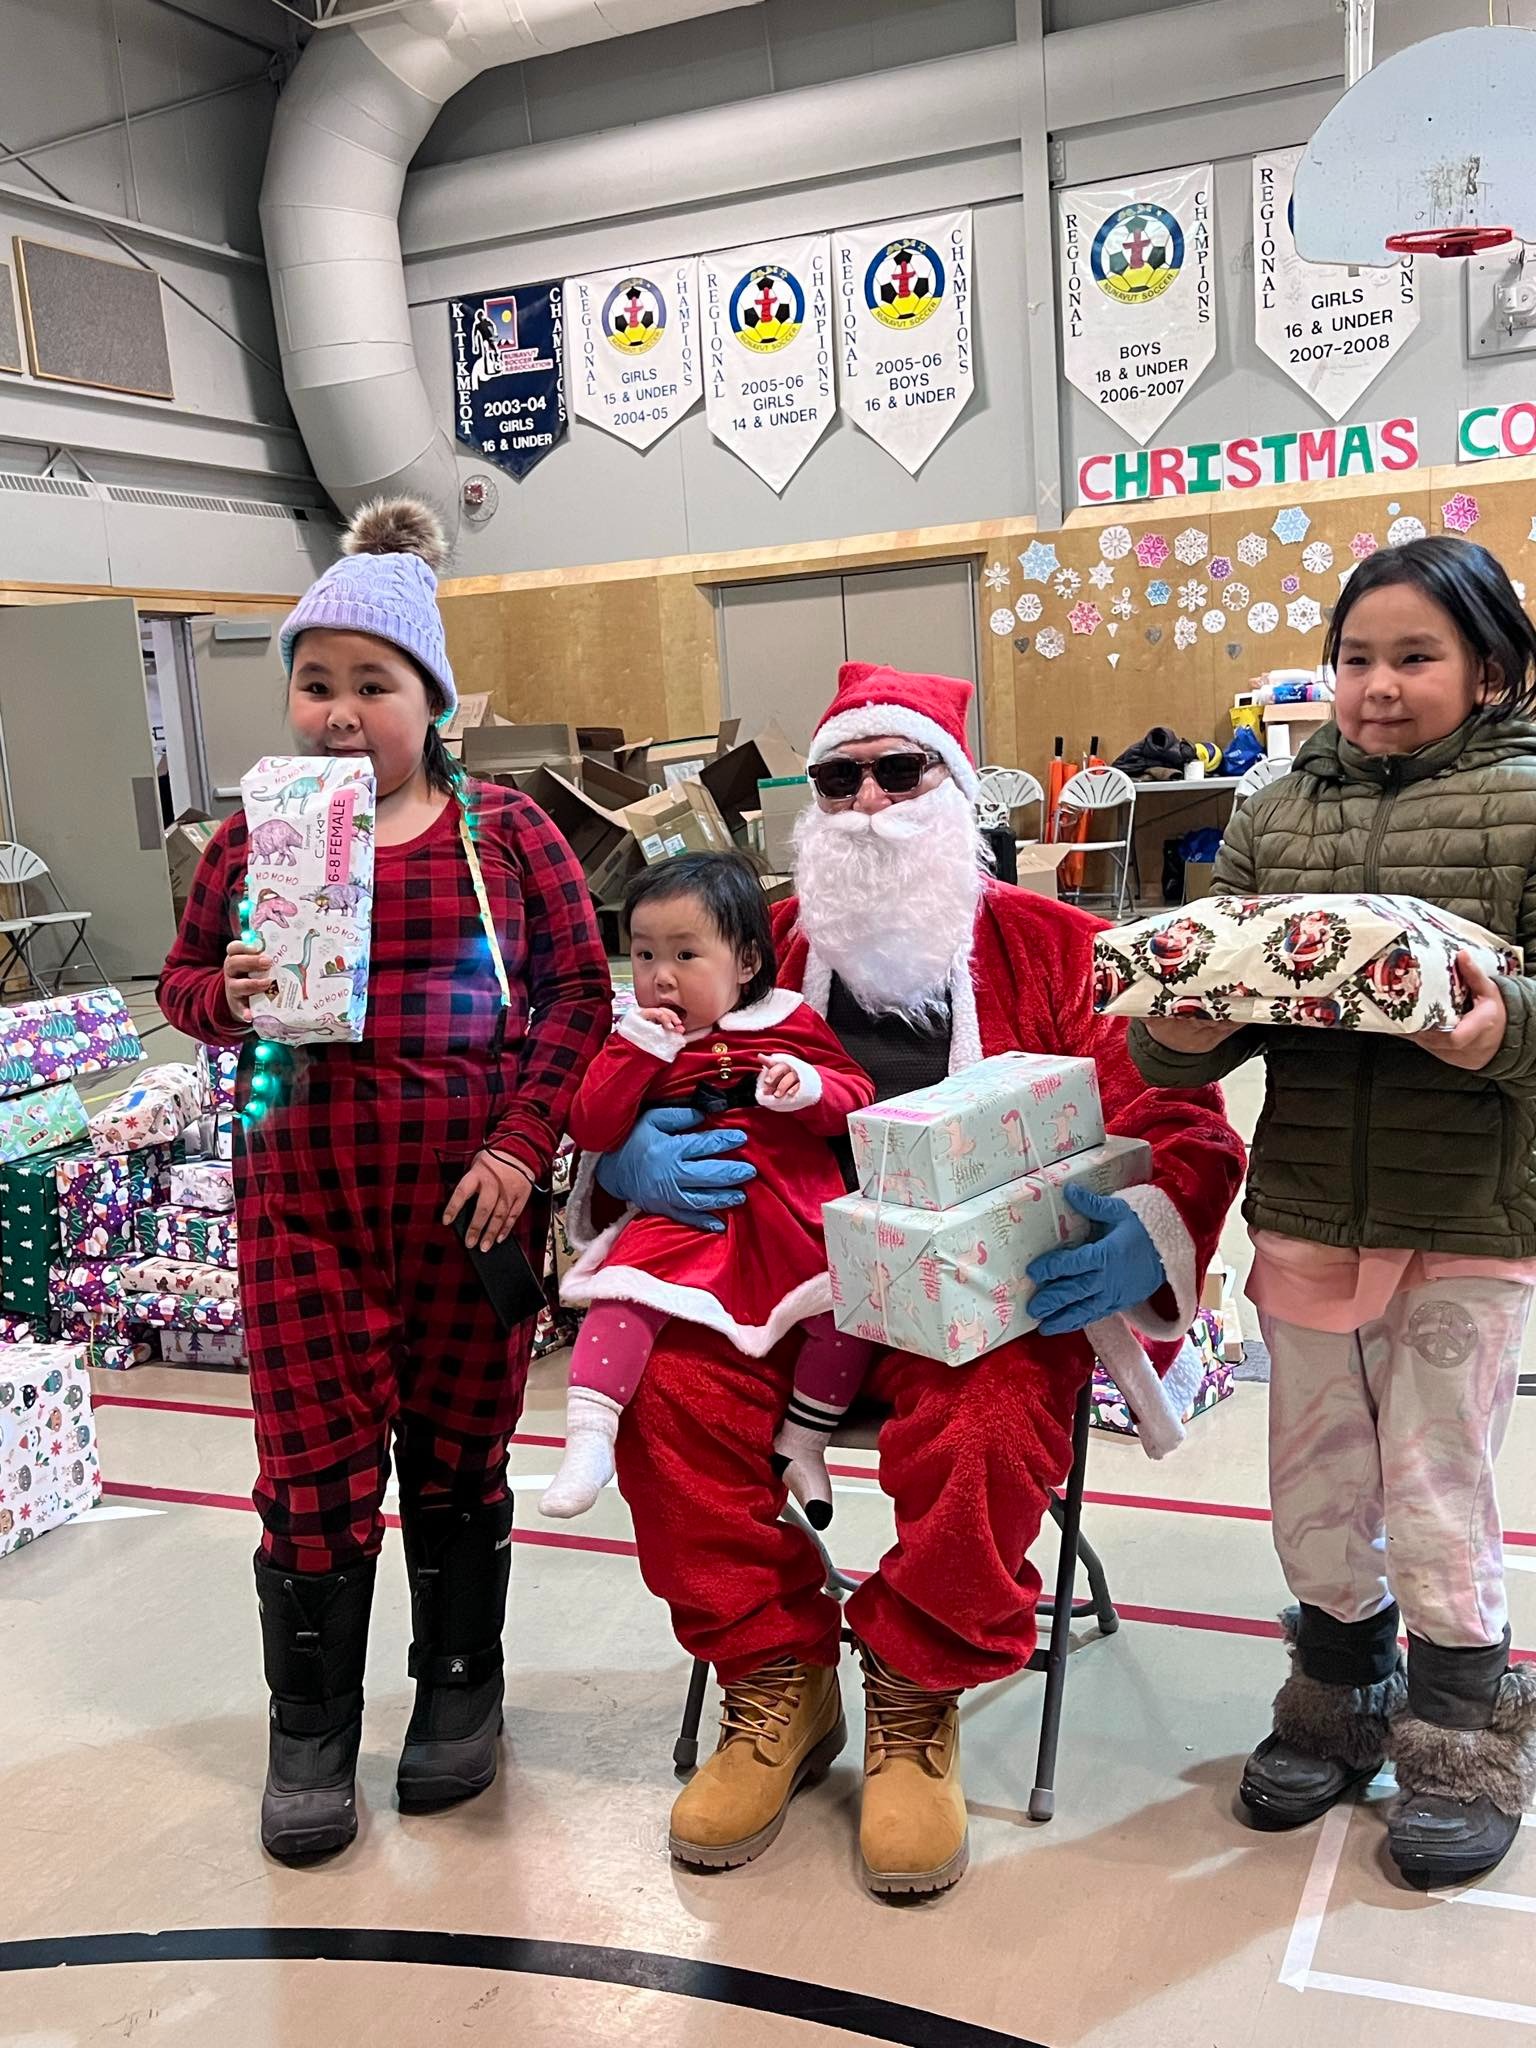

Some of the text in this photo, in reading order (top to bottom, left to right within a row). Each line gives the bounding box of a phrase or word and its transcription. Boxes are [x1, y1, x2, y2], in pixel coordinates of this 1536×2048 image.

[1260, 168, 1276, 309] REGIONAL
[1194, 191, 1210, 324] CHAMPIONS
[1066, 214, 1082, 337] REGIONAL
[1103, 273, 1175, 301] NUNAVUT SOCCER
[951, 229, 969, 375] CHAMPIONS
[1311, 288, 1364, 309] GIRLS
[841, 249, 858, 377] REGIONAL
[876, 302, 938, 328] NUNAVUT SOCCER
[1284, 309, 1393, 338] 16 & UNDER
[677, 269, 693, 386] CHAMPIONS
[707, 273, 725, 399] REGIONAL
[812, 256, 829, 397] CHAMPIONS
[580, 285, 596, 396] REGIONAL
[1119, 341, 1162, 360] BOYS
[1289, 334, 1390, 363] 2007-2008
[451, 303, 474, 435] KITIKMEOT
[621, 368, 658, 384] GIRLS
[875, 353, 942, 375] 2005-06
[1095, 358, 1189, 383] 18 & UNDER
[741, 375, 804, 396] 2005-06
[889, 373, 930, 390] BOYS
[1100, 379, 1185, 404] 2006-2007
[484, 396, 547, 417] 2003-04
[604, 384, 678, 405] 15 & UNDER
[753, 393, 795, 411] GIRLS
[865, 387, 956, 411] 16 & UNDER
[499, 418, 534, 434] GIRLS
[613, 407, 669, 426] 2004-05
[732, 407, 817, 431] 14 & UNDER
[482, 434, 553, 453] 16 & UNDER
[1079, 402, 1536, 501] CHRISTMAS CO
[328, 800, 345, 882] 6-8 FEMALE
[326, 923, 340, 934] HO
[341, 928, 355, 940] HO
